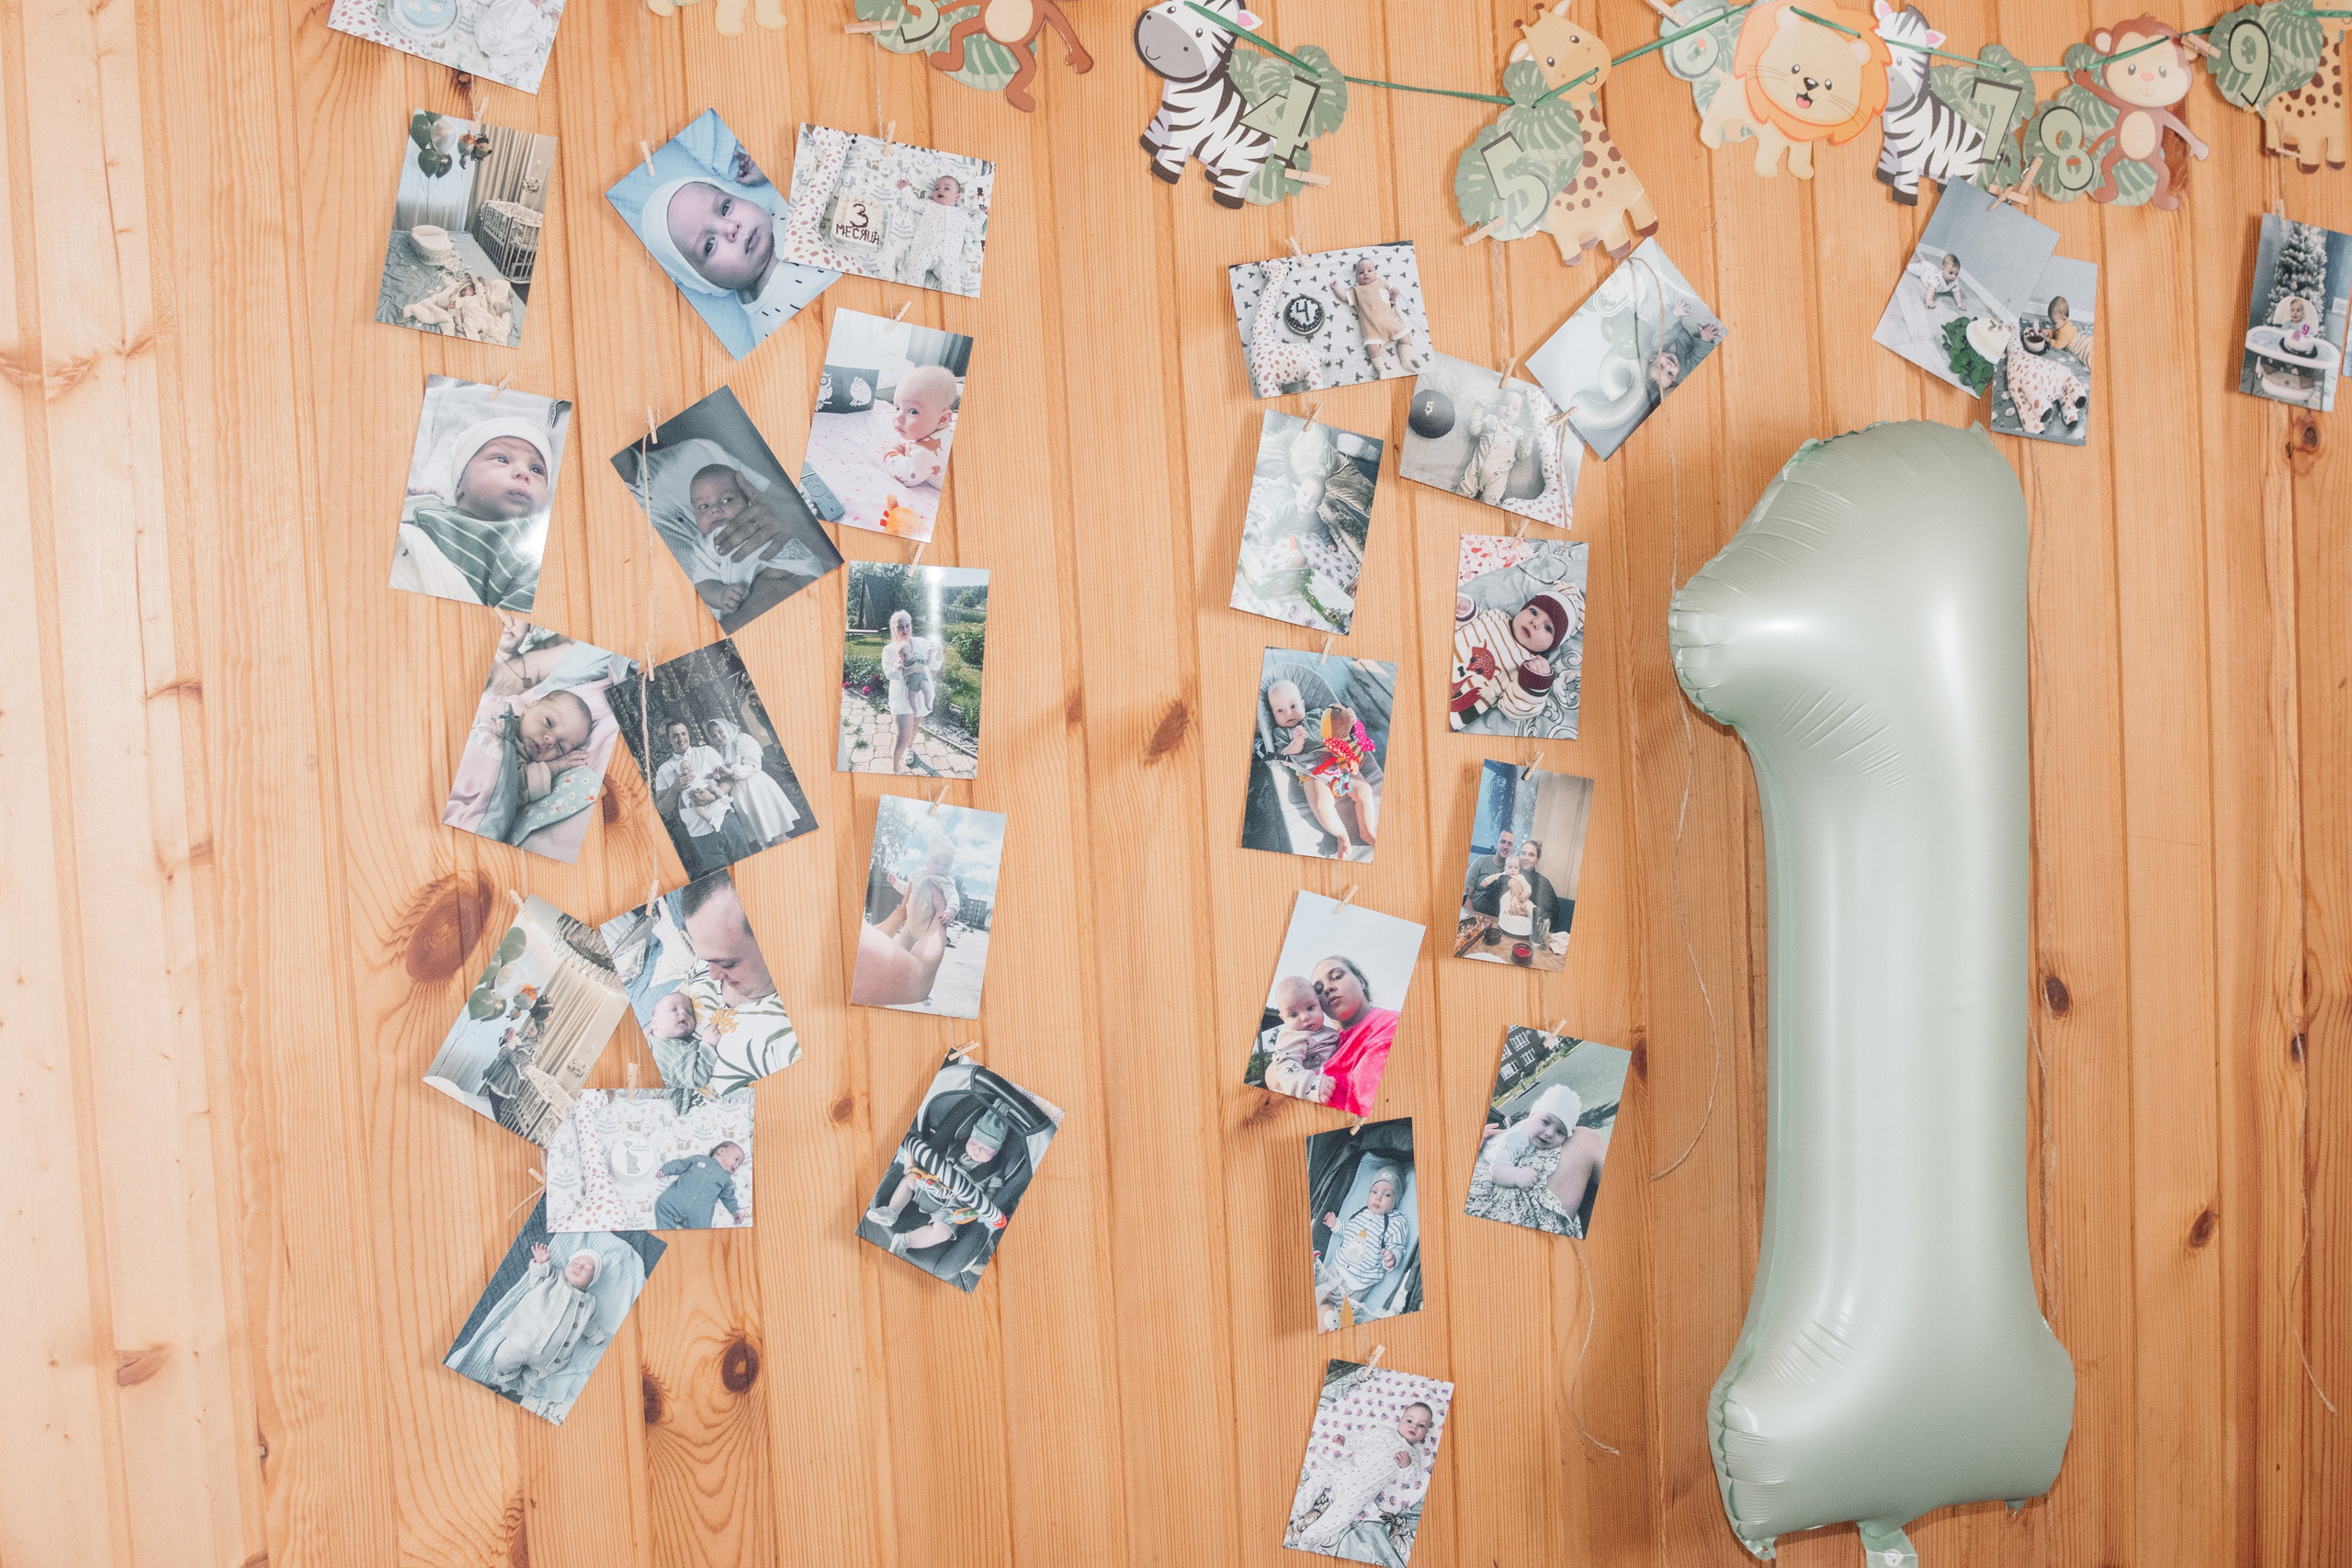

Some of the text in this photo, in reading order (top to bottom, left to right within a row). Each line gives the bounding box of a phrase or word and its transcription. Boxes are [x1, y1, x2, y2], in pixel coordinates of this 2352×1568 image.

[1670, 5, 1729, 78] 6
[2228, 18, 2271, 107] 9
[1238, 74, 1320, 163] 4
[1971, 77, 2022, 164] 7
[2039, 106, 2095, 191] 8
[850, 203, 868, 228] 3
[1480, 130, 1550, 233] 5
[836, 223, 880, 245] МЕСЯЦА
[1296, 301, 1309, 321] 4
[1424, 400, 1433, 416] 5
